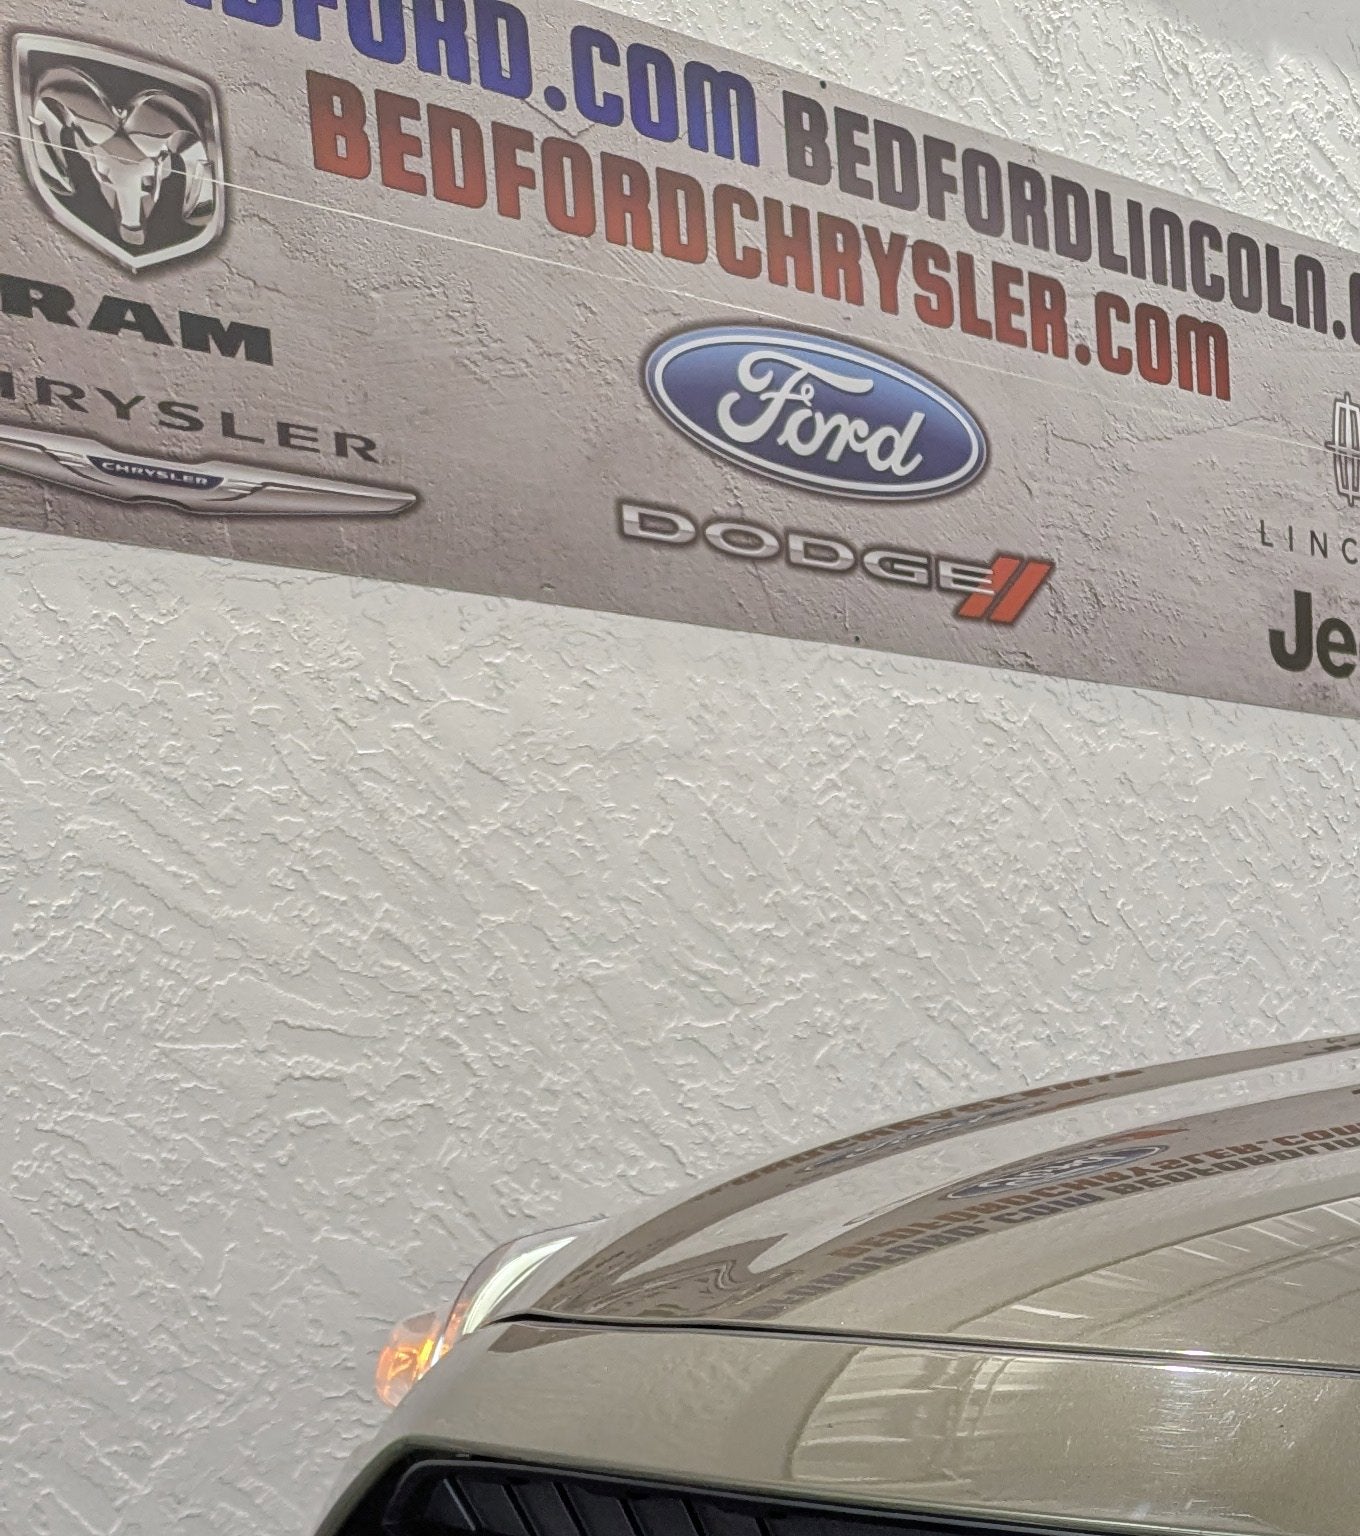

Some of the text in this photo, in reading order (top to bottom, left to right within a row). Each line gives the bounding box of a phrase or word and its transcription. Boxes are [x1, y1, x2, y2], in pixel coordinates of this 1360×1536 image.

[185, 0, 759, 167] ORD.COM
[306, 70, 1231, 401] BEDFORDCHRYSLER.COM
[0, 273, 273, 366] RAM
[717, 350, 925, 476] Ford
[102, 462, 208, 485] CHRYSLER
[621, 503, 995, 595] DODGE
